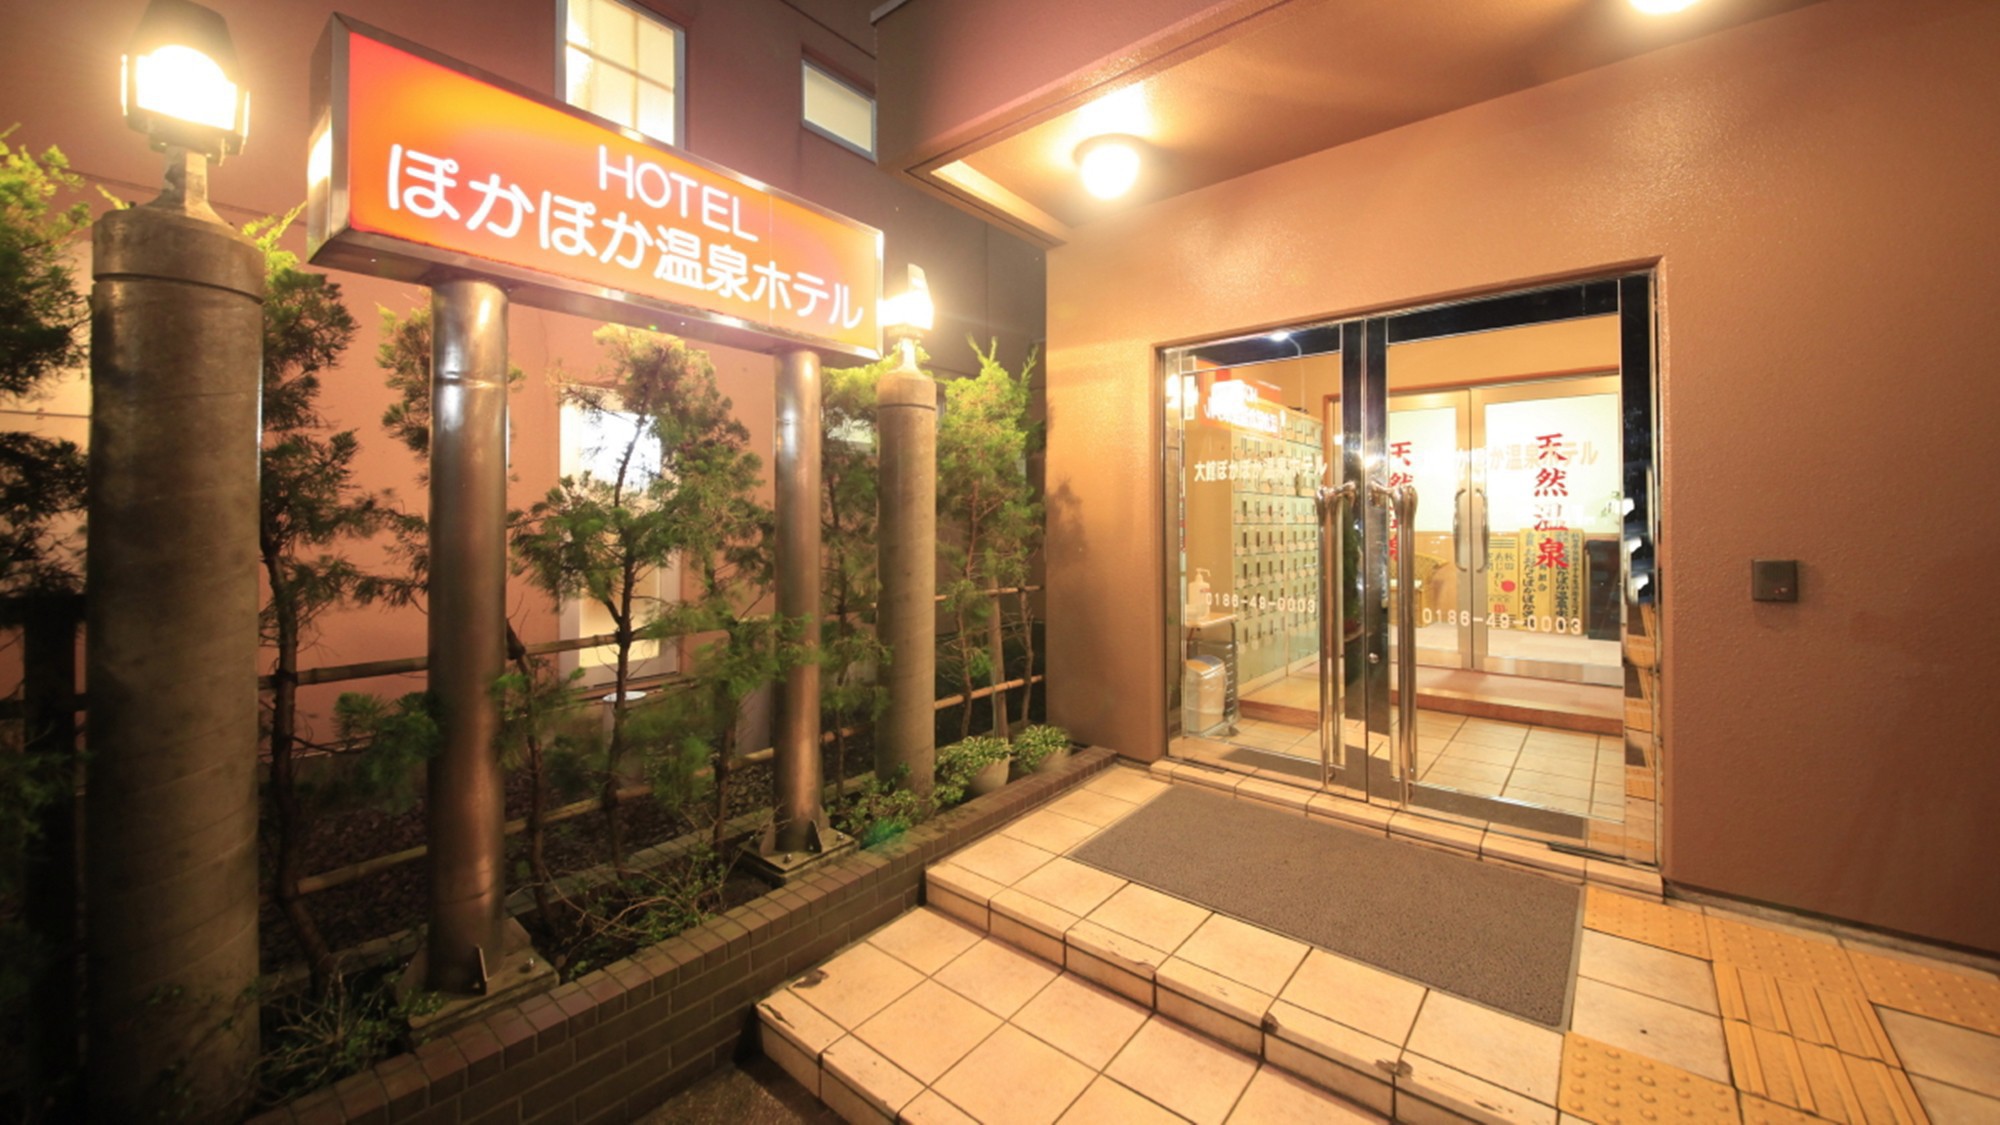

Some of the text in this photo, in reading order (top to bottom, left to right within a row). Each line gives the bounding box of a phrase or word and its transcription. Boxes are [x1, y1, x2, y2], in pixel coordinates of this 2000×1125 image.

[387, 143, 864, 331] ぽかぽか温泉ホテル
[598, 144, 758, 242] HOTEL
[1533, 432, 1570, 569] 天然温泉
[1206, 592, 1316, 614] 0186-49-0003
[1422, 607, 1582, 635] 0186-49-0003
